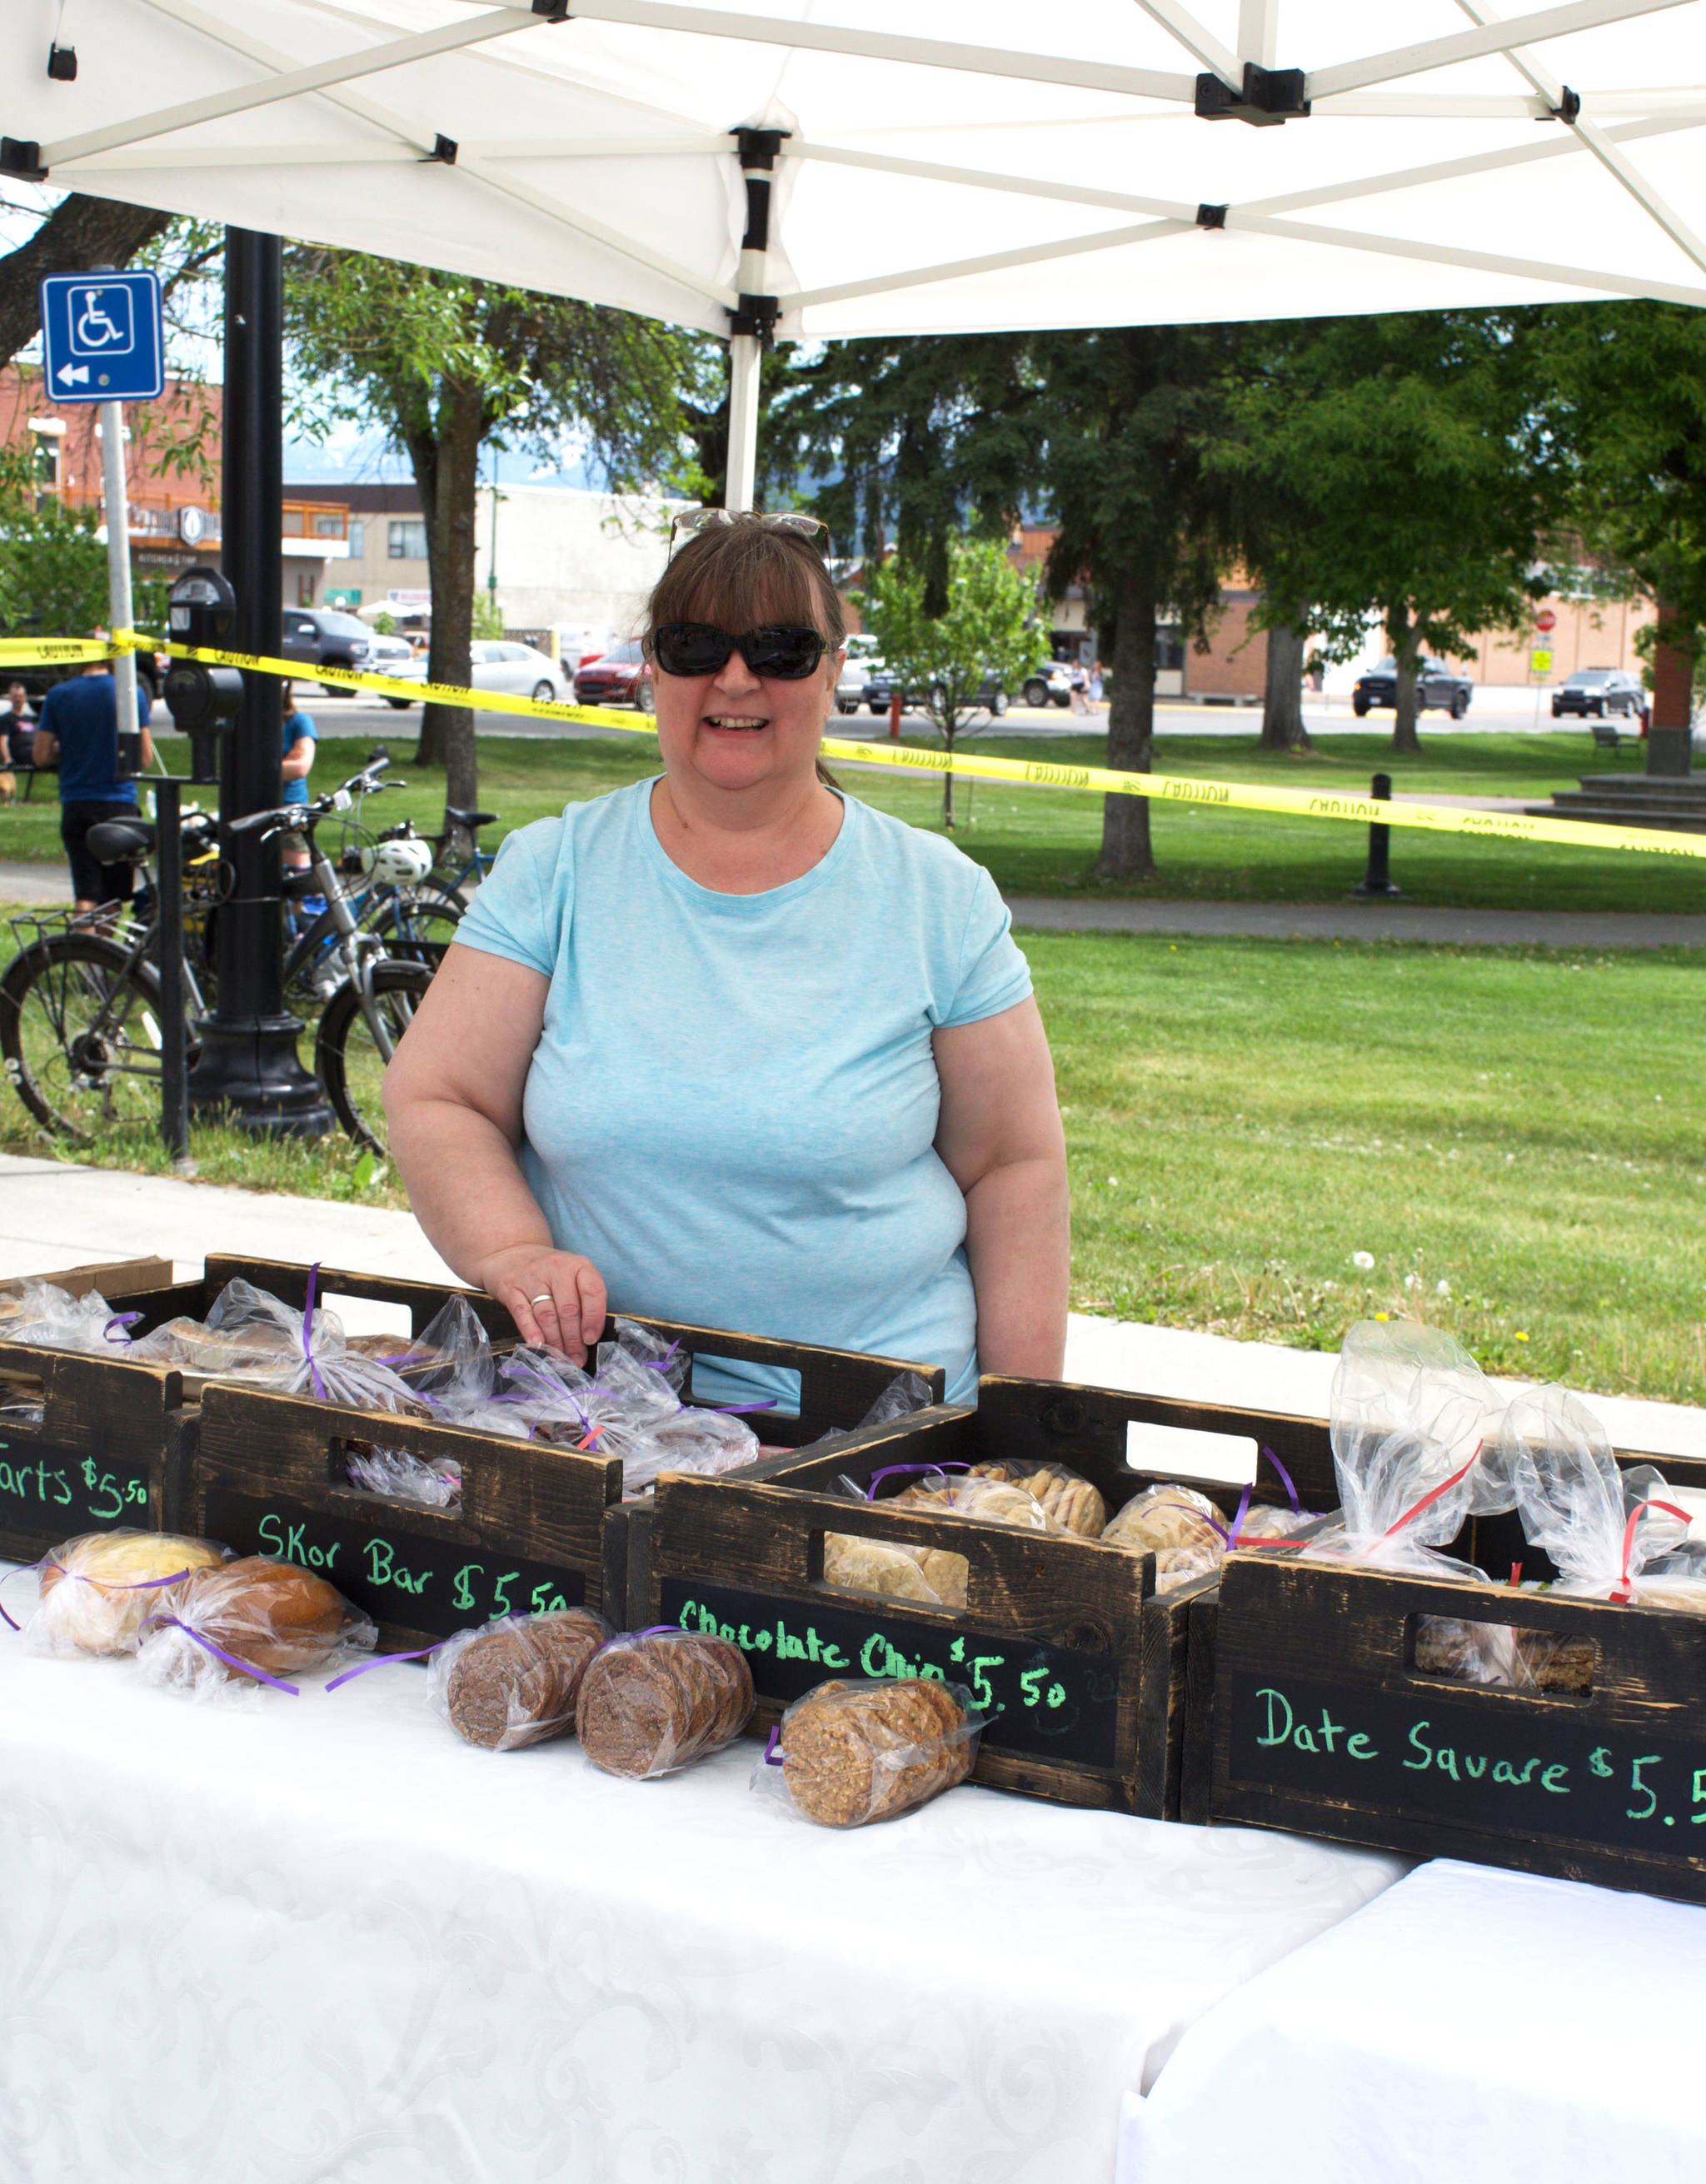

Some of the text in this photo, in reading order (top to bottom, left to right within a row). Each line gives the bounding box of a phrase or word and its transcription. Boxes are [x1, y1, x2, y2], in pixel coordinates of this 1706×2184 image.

[37, 644, 83, 659] CAUTION
[215, 649, 260, 666] CAUTION
[315, 665, 364, 681] CAUTION
[0, 1442, 147, 1519] arts $5.50
[363, 1538, 433, 1594] Bar
[679, 1599, 851, 1668] Chocolate
[1255, 1688, 1379, 1759] Date
